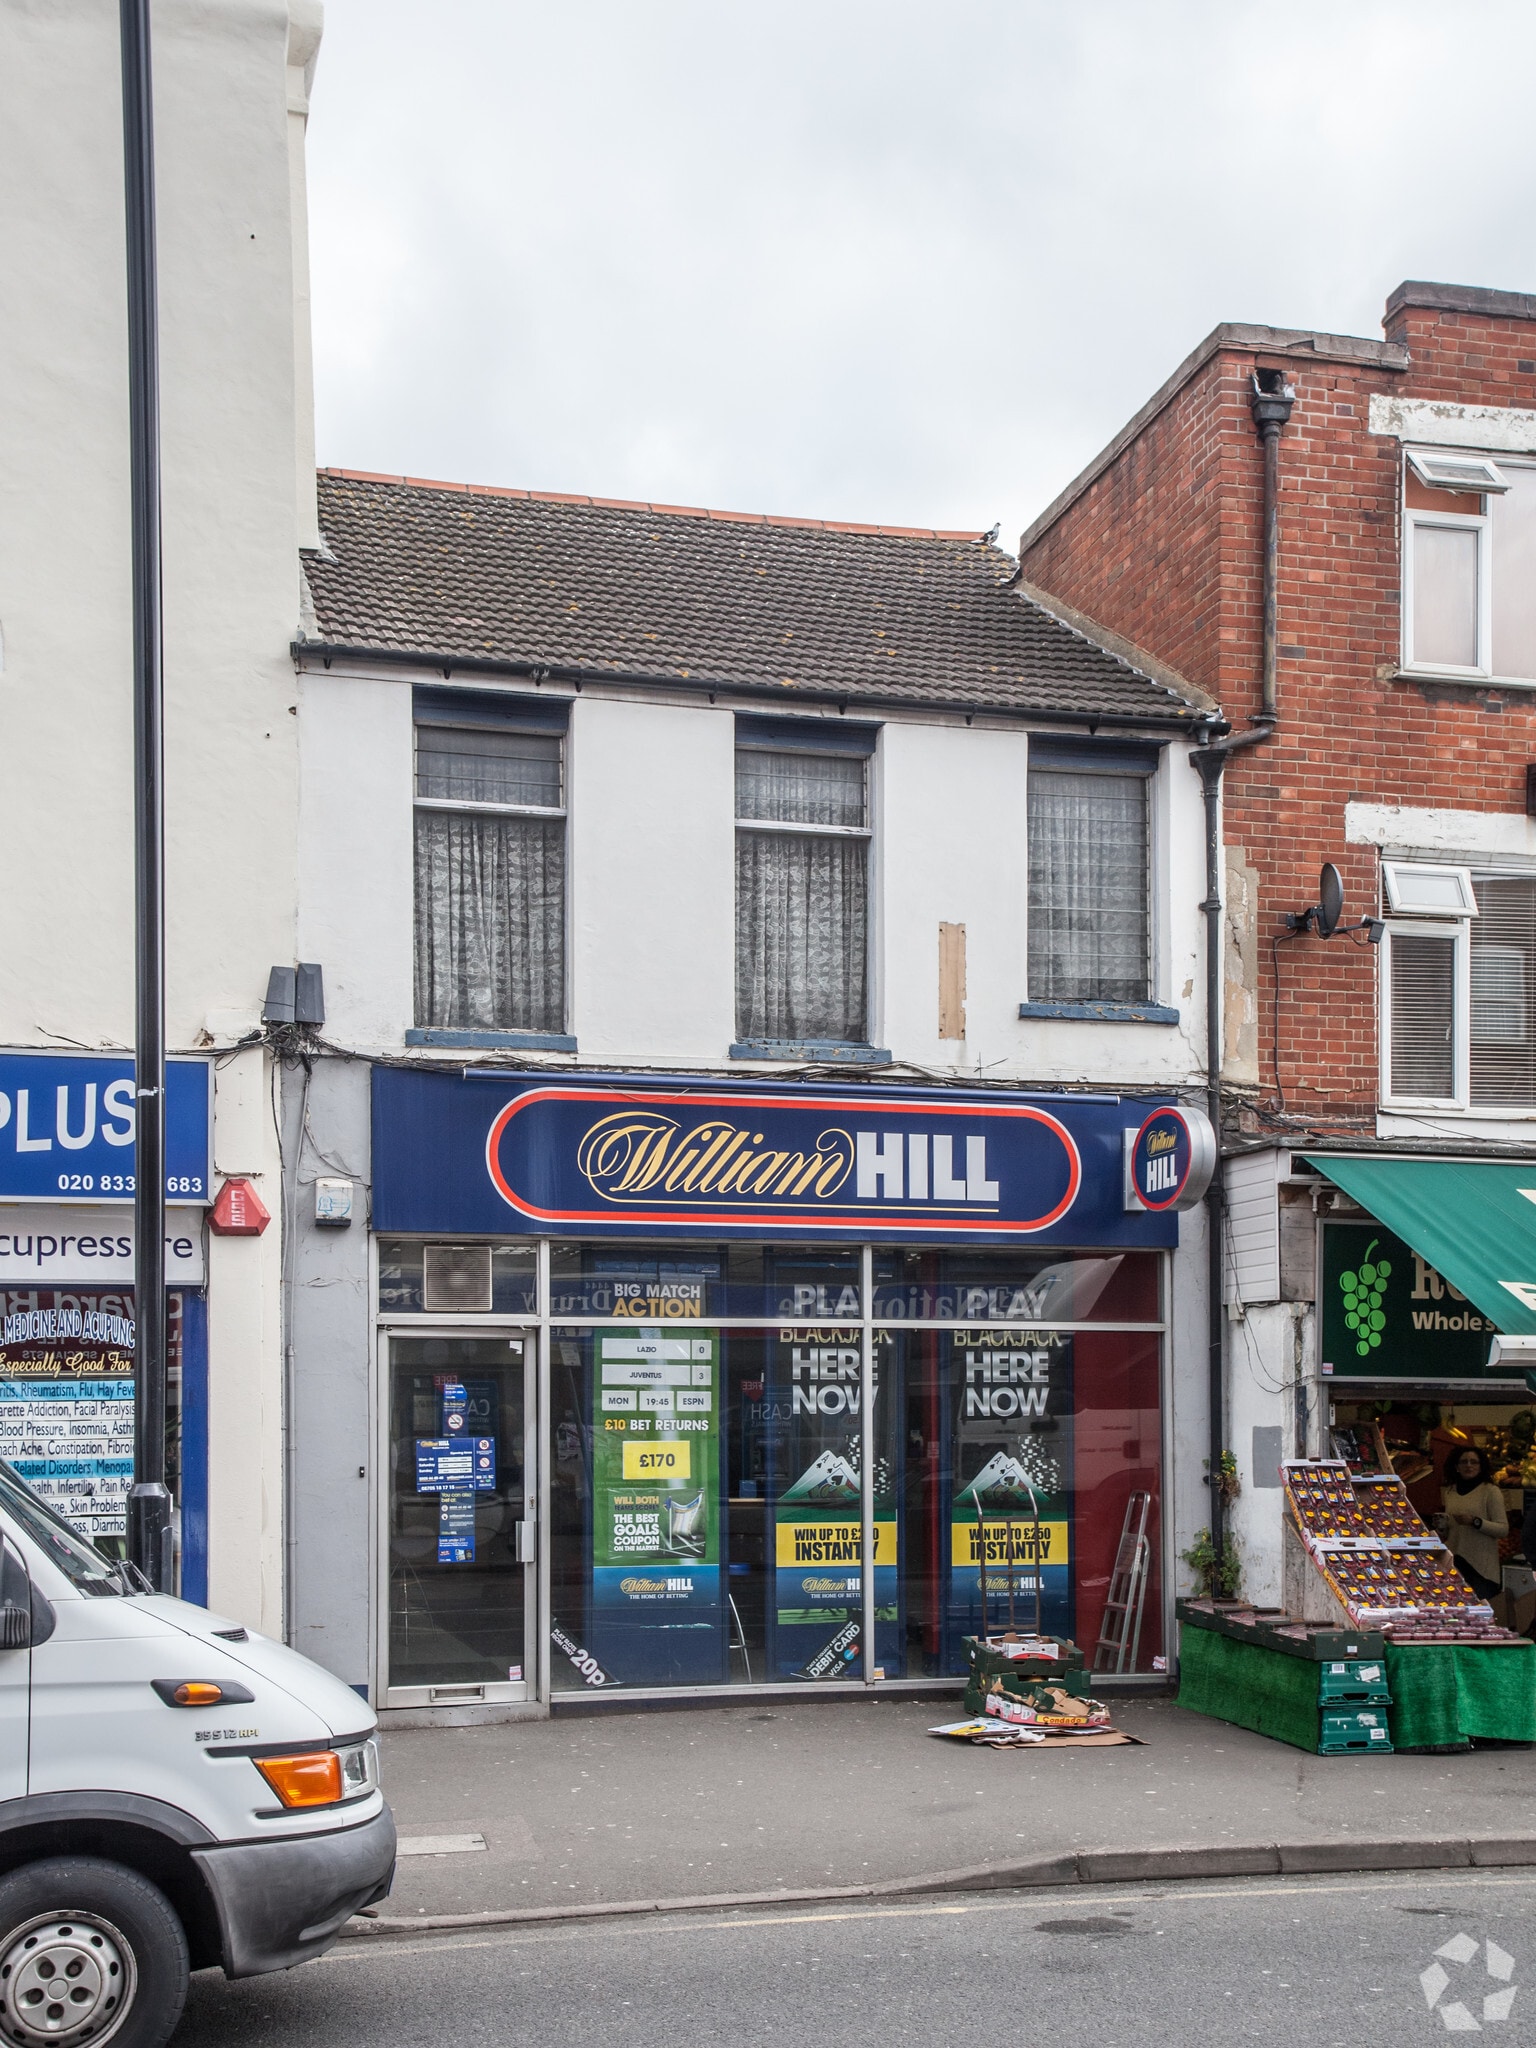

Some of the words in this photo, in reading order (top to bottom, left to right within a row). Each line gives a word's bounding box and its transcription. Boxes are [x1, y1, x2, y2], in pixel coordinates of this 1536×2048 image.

[1146, 1127, 1178, 1157] William
[577, 1110, 855, 1206] William
[856, 1131, 999, 1201] HILL
[1146, 1154, 1178, 1193] HILL
[58, 1174, 94, 1190] 020
[100, 1175, 137, 1191] 833
[167, 1177, 202, 1193] 683
[614, 1284, 642, 1298] BIG
[646, 1284, 700, 1299] MATCH
[612, 1298, 700, 1318] ACTION
[966, 1287, 1048, 1319] PLAY
[5, 1309, 56, 1344] MEDICINE
[57, 1309, 82, 1337] AND
[1412, 1311, 1502, 1332] Wholes
[699, 1346, 705, 1354] 0
[66, 1352, 105, 1378] Good
[108, 1351, 132, 1371] For
[966, 1351, 1050, 1382] HERE
[21, 1383, 76, 1398] Rheumatism,
[80, 1382, 94, 1397] Flu,
[97, 1382, 114, 1400] Hay
[27, 1402, 71, 1417] Addiction,
[75, 1401, 97, 1416] Facial
[608, 1397, 629, 1405] MON
[646, 1398, 669, 1406] 19:45
[682, 1397, 704, 1406] ESPN
[966, 1387, 1050, 1417] NOW
[26, 1421, 66, 1437] Pressure,
[70, 1421, 110, 1436] Insomnia,
[605, 1419, 626, 1431] £10
[630, 1420, 651, 1431] BET
[655, 1420, 709, 1431] RETURNS
[20, 1441, 45, 1457] Ache,
[48, 1440, 105, 1458] Constipation,
[49, 1460, 93, 1475] Disorders,
[639, 1453, 675, 1467] £170
[101, 1478, 117, 1492] Pain
[70, 1498, 88, 1513] Skin
[614, 1496, 634, 1505] WILL
[636, 1496, 659, 1505] BOTH
[614, 1514, 633, 1523] THE
[636, 1513, 659, 1523] BEST
[614, 1524, 659, 1536] GOALS
[794, 1529, 816, 1541] WIN
[819, 1529, 833, 1540] UP
[835, 1529, 848, 1540] TO
[993, 1528, 1007, 1540] UP
[614, 1536, 659, 1546] COUPON
[621, 1577, 667, 1595] William
[667, 1578, 694, 1591] HILL
[802, 1577, 847, 1593] William
[553, 1628, 566, 1640] PLAY
[809, 1649, 836, 1678] DEBIT
[834, 1624, 861, 1652] CARD
[570, 1648, 606, 1686] 20p
[828, 1660, 845, 1676] VISA
